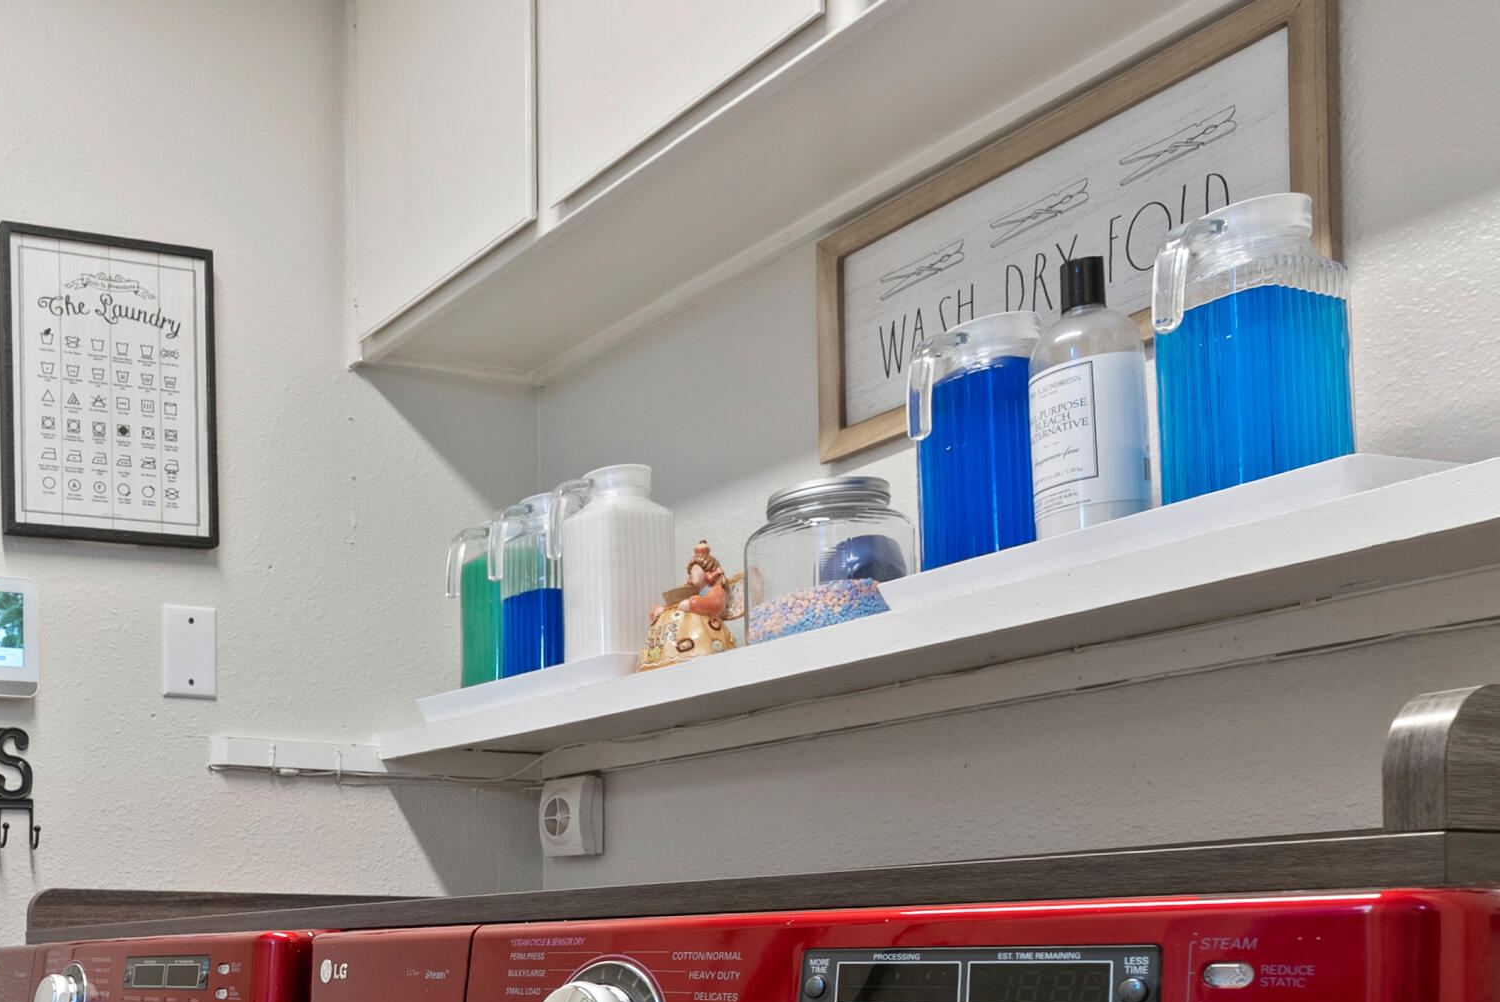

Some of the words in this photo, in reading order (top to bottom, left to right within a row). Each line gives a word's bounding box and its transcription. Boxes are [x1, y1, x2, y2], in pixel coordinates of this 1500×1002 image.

[879, 283, 975, 379] WASH
[1108, 172, 1230, 284] FOLD
[37, 294, 91, 317] The
[94, 292, 182, 339] Laundry
[1034, 410, 1072, 432] BLEACH
[1200, 937, 1258, 950] STEAM
[672, 951, 742, 961] COTTON/NORMAL
[873, 953, 921, 961] PROCESSING
[997, 952, 1014, 960] EST.
[1015, 952, 1034, 960] TIME
[1035, 951, 1082, 960] REMAINING
[1124, 956, 1149, 965] LESS
[809, 958, 830, 967] MORE
[333, 963, 349, 980] LG
[811, 966, 828, 974] TIME
[1124, 965, 1149, 974] TIME
[1260, 964, 1315, 976] REDUCE
[688, 970, 716, 980] HEAVY
[717, 971, 741, 981] DUTY
[1260, 977, 1306, 989] STATIC
[505, 986, 524, 995] SMALL
[525, 987, 541, 995] LOAD
[693, 991, 739, 1002] DELICATES
